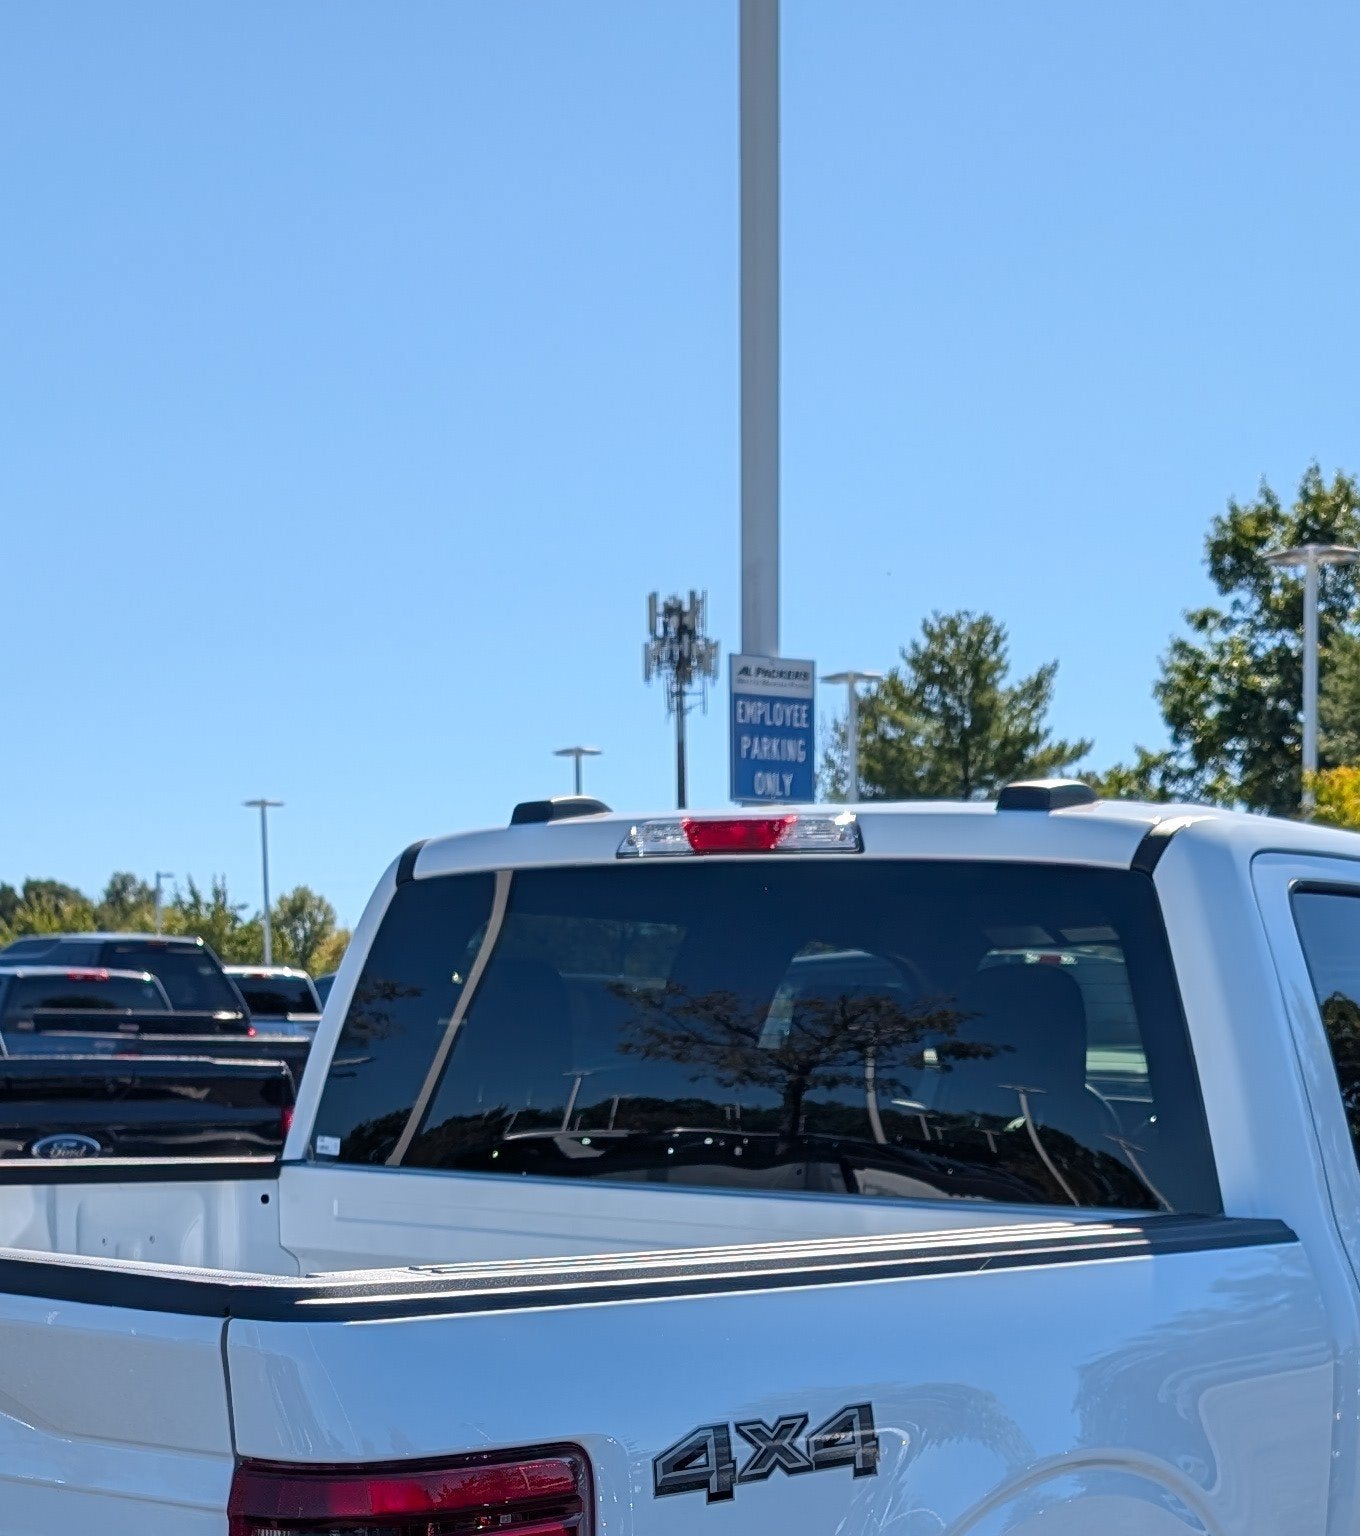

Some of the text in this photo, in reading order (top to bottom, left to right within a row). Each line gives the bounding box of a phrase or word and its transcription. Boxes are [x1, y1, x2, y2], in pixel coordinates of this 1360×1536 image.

[736, 700, 809, 728] EMPLOYEE
[740, 735, 806, 763] PARKING
[754, 771, 793, 797] ONLY
[49, 1141, 87, 1159] Ford
